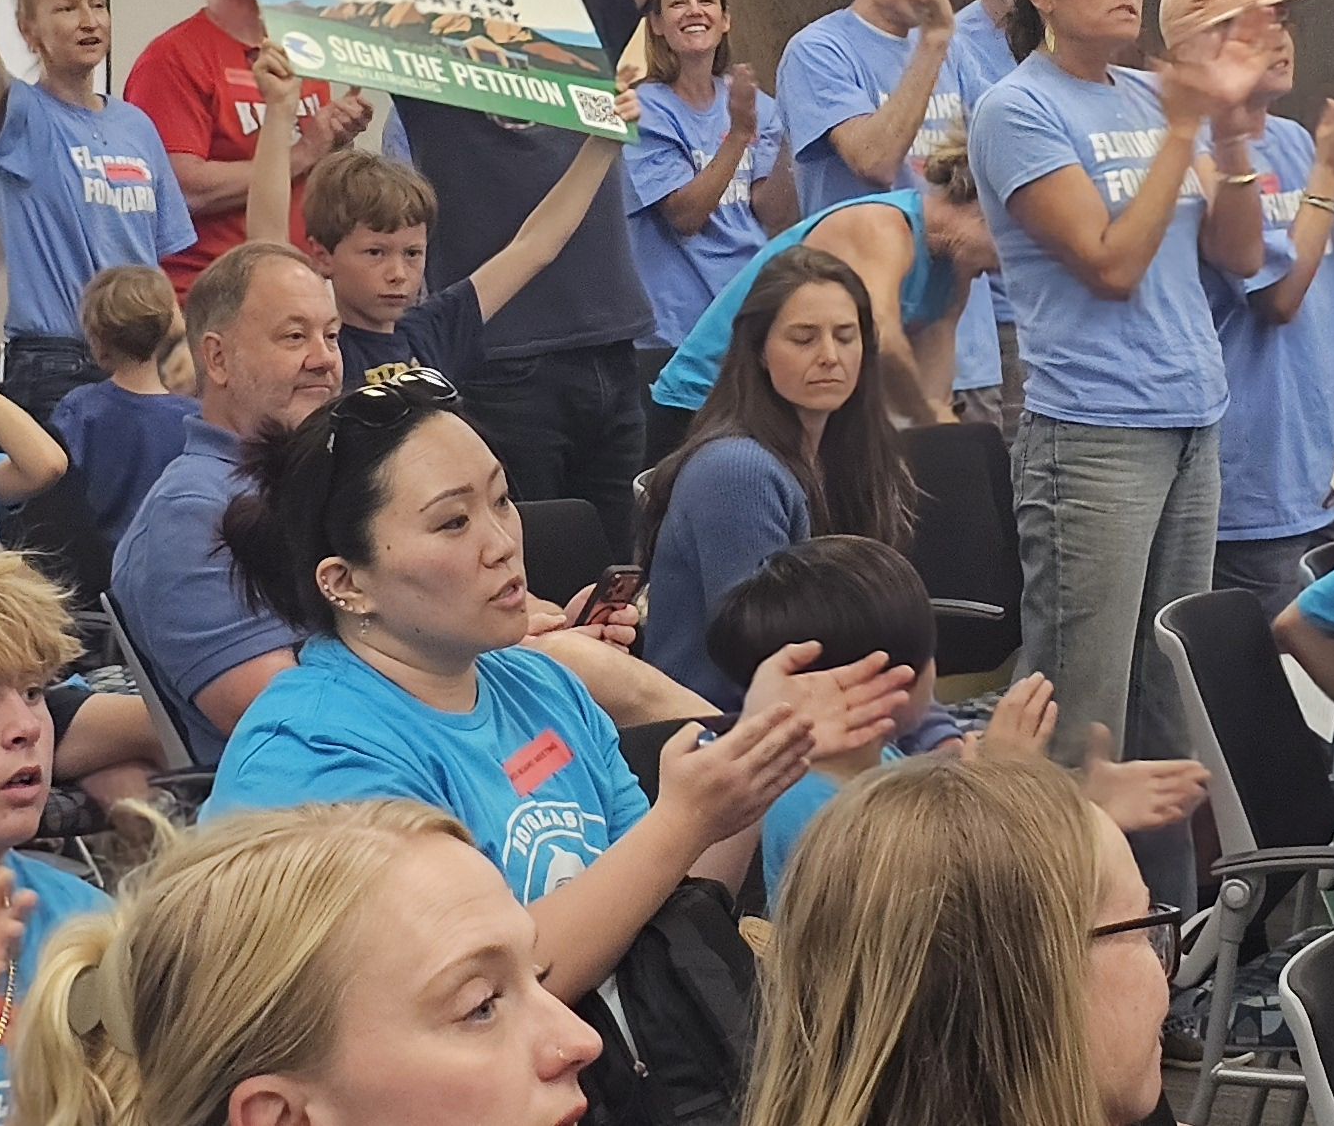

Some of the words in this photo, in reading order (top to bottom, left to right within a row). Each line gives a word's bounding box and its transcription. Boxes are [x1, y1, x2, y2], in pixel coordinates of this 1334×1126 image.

[326, 33, 394, 74] SIGN
[392, 47, 453, 84] THE
[455, 60, 568, 109] PETITION
